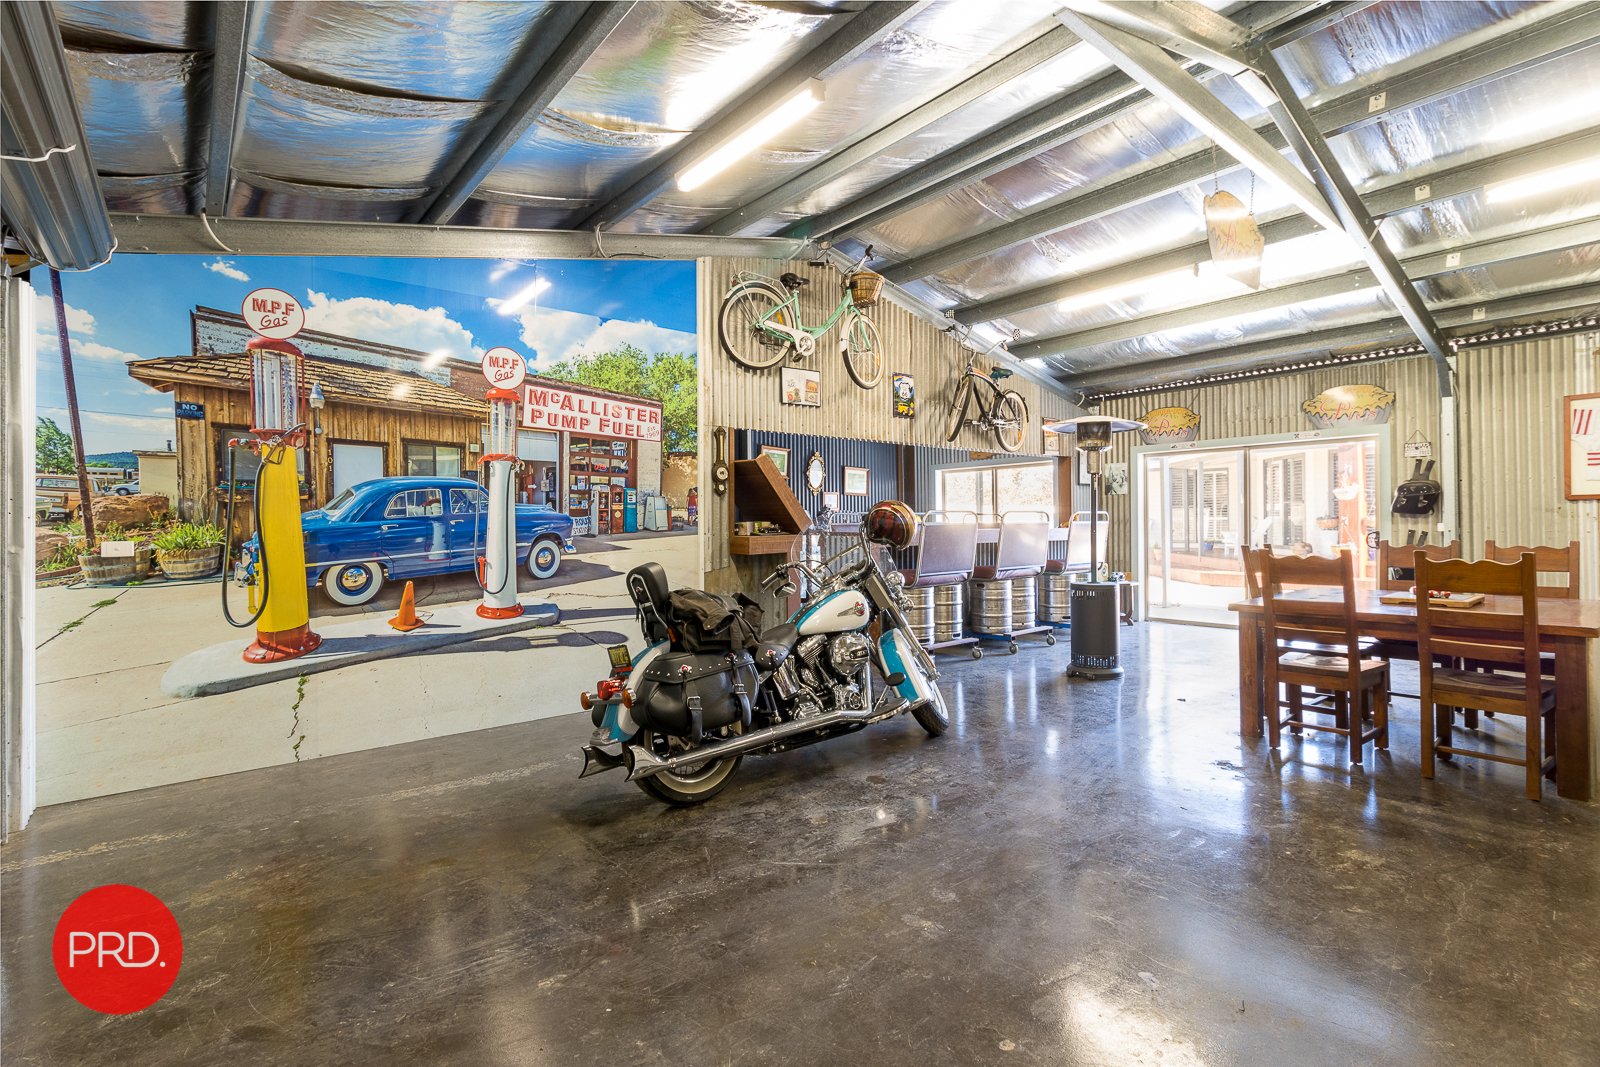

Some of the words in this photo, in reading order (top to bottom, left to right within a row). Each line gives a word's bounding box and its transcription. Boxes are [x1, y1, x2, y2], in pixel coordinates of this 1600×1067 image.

[252, 298, 295, 316] M.P.F
[259, 314, 288, 330] Gas
[489, 356, 519, 370] M.P.F
[494, 369, 514, 382] Gas
[181, 403, 198, 411] NO
[530, 408, 591, 431] PUMP
[599, 417, 645, 438] FUEL
